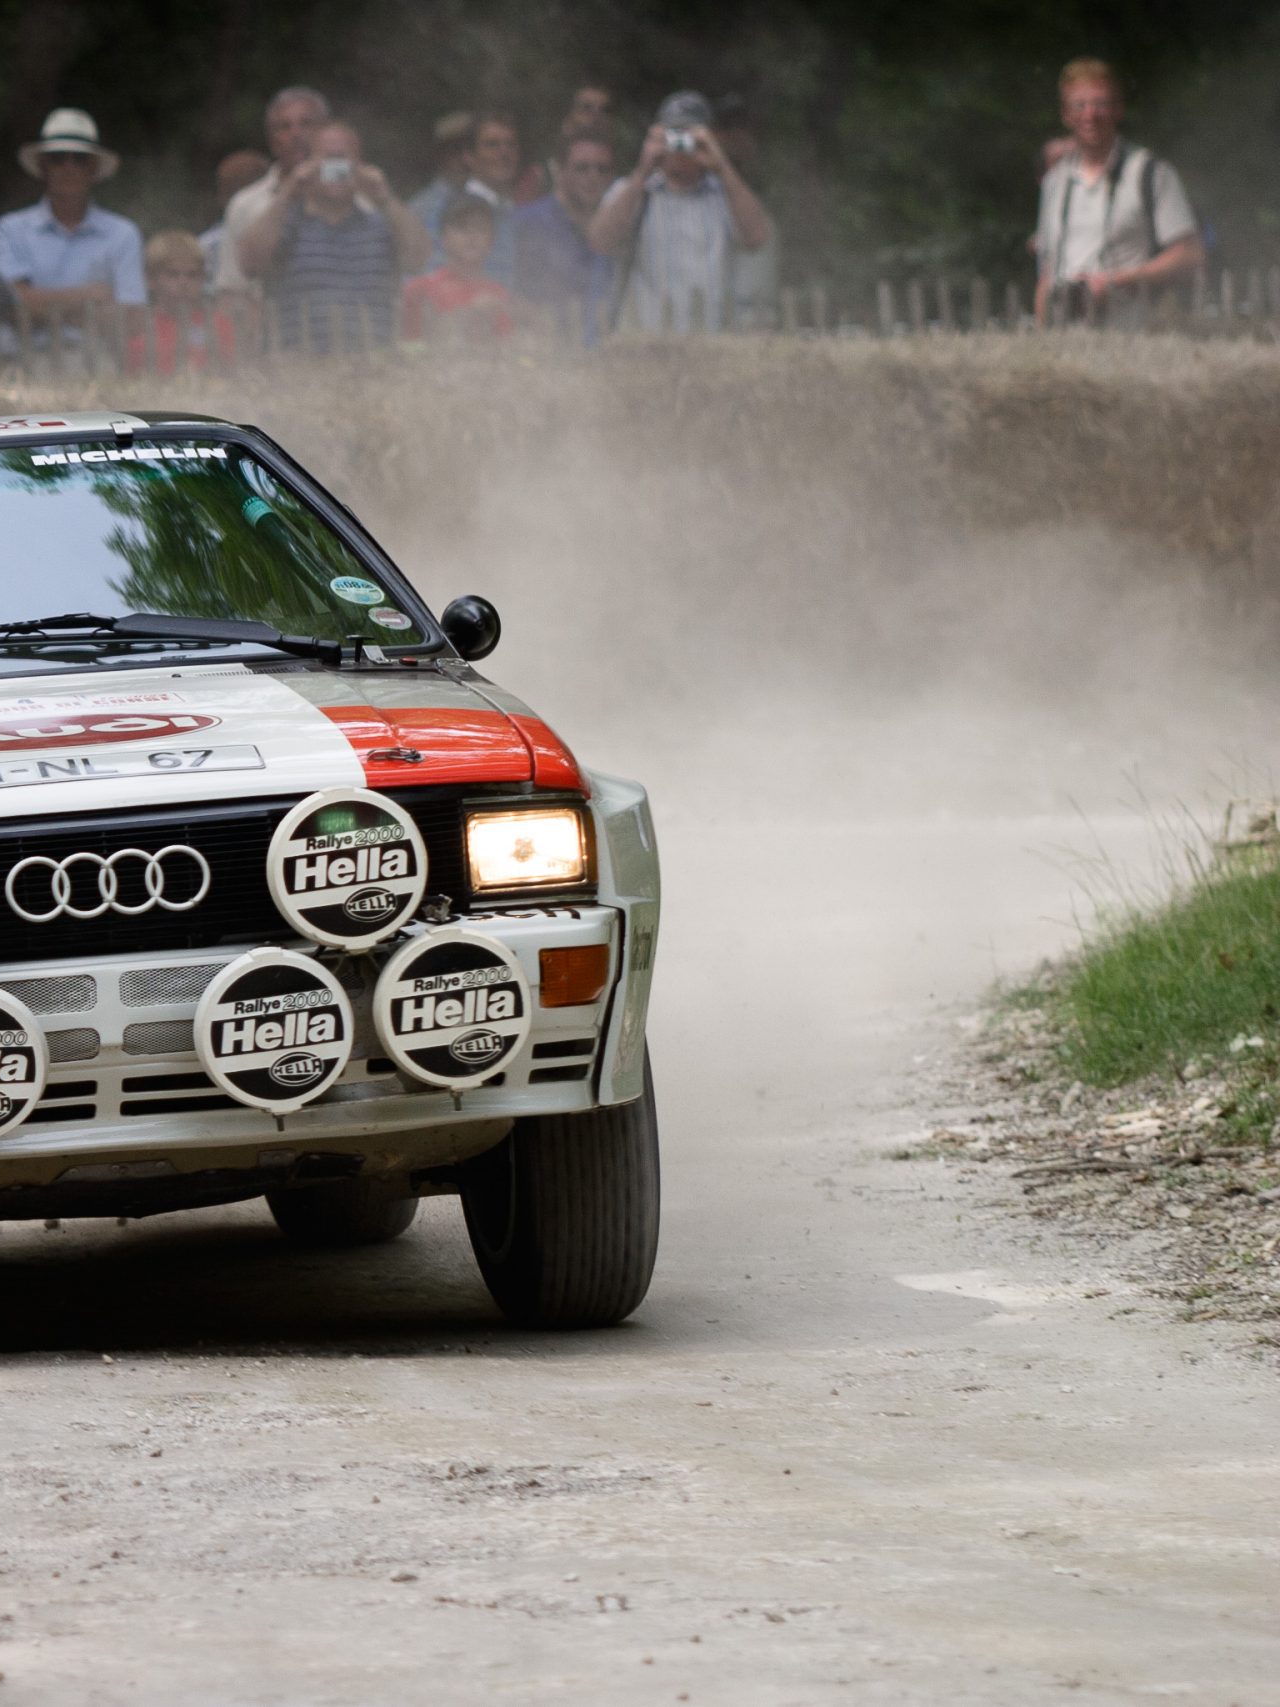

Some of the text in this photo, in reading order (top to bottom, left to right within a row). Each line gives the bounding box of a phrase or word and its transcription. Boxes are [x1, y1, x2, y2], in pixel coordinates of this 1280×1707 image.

[32, 447, 228, 466] MICHELIN
[148, 749, 214, 769] 67
[306, 824, 405, 852] Rallye 2000
[294, 846, 409, 892] Hella
[347, 893, 397, 912] HELLA
[414, 966, 512, 993] Rallye 2000
[234, 989, 333, 1015] Rallye 2000
[401, 988, 516, 1033] Hella
[221, 1012, 337, 1055] Hella
[453, 1036, 504, 1053] HELLA
[272, 1059, 324, 1077] HELLA
